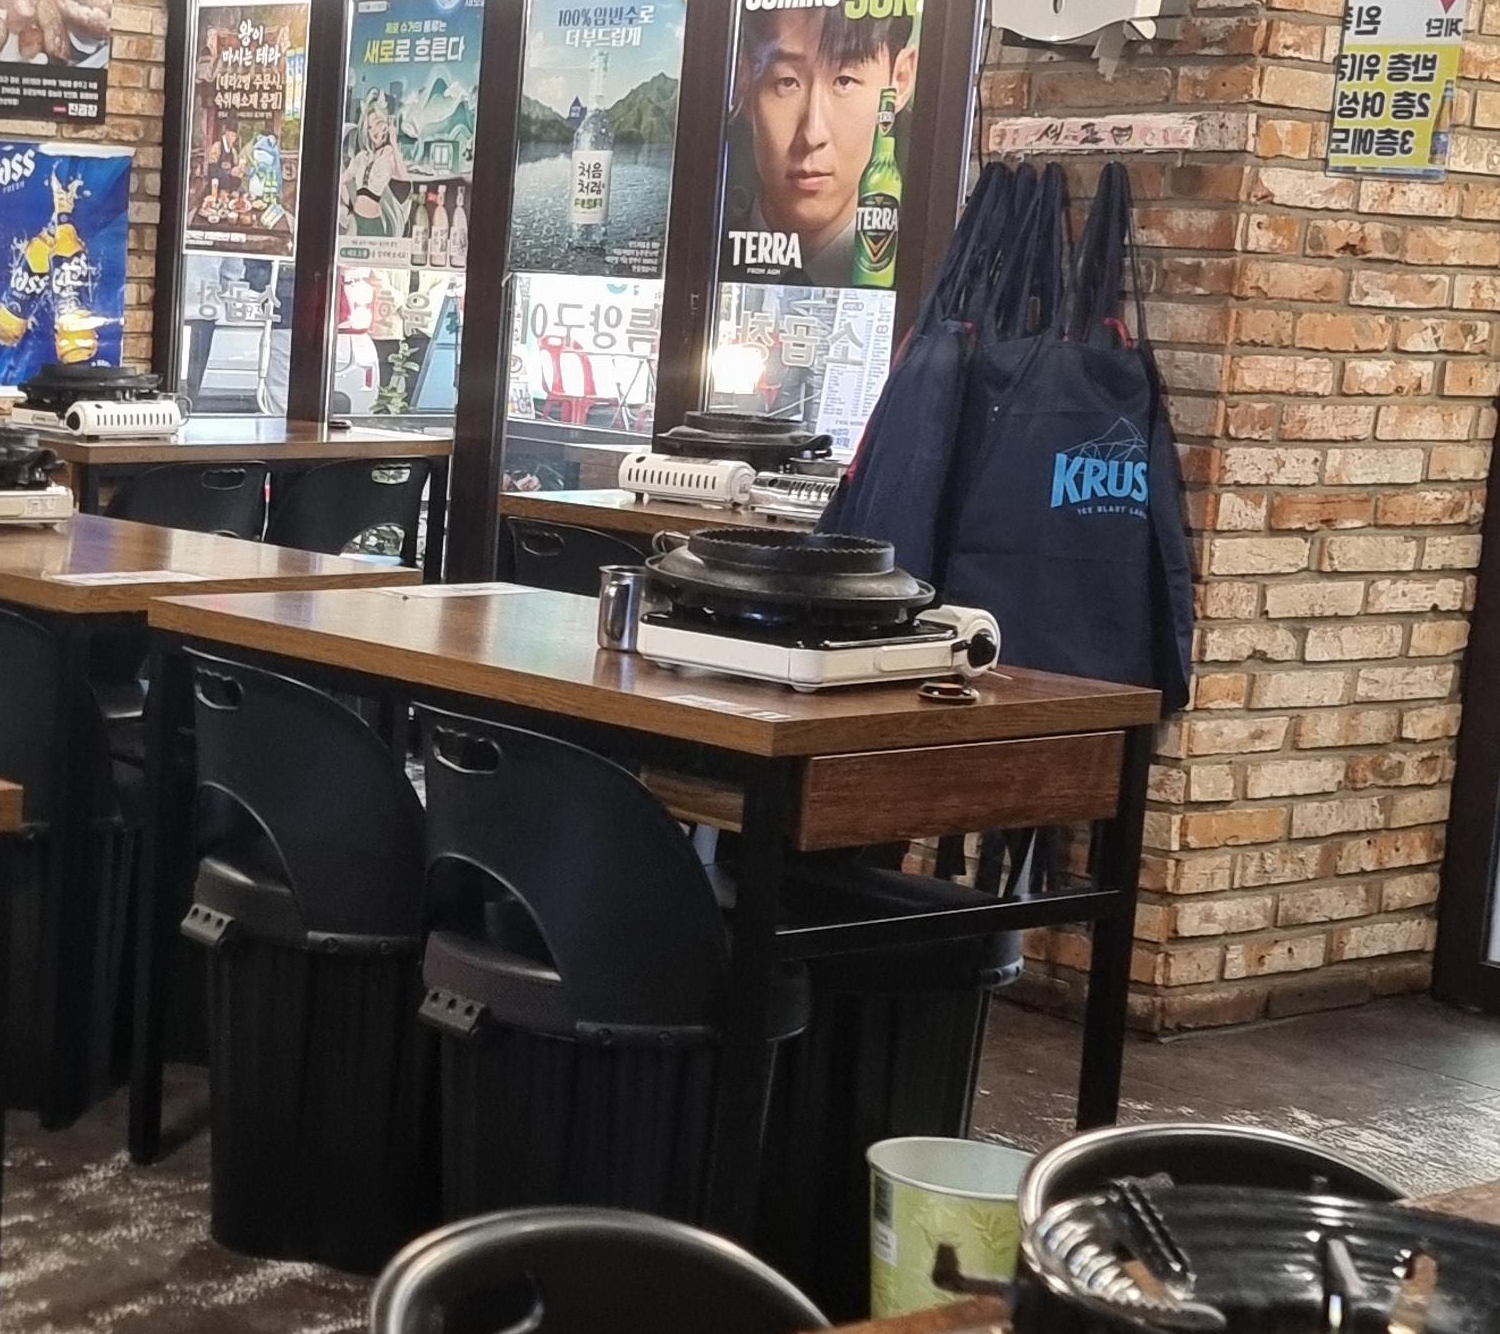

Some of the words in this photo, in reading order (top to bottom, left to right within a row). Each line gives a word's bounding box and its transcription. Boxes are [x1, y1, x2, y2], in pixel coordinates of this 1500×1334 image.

[238, 19, 264, 46] 왕이
[565, 30, 580, 49] 더
[582, 27, 643, 49] 부드럽게
[221, 46, 254, 67] 마시는
[255, 44, 281, 67] 테라
[363, 38, 411, 64] 새로로
[414, 35, 466, 63] 흐른다
[578, 162, 604, 179] 처음
[577, 180, 604, 196] 처럼
[855, 205, 899, 231] TERRA
[727, 231, 803, 269] TERRA
[1050, 452, 1149, 508] KRUS
